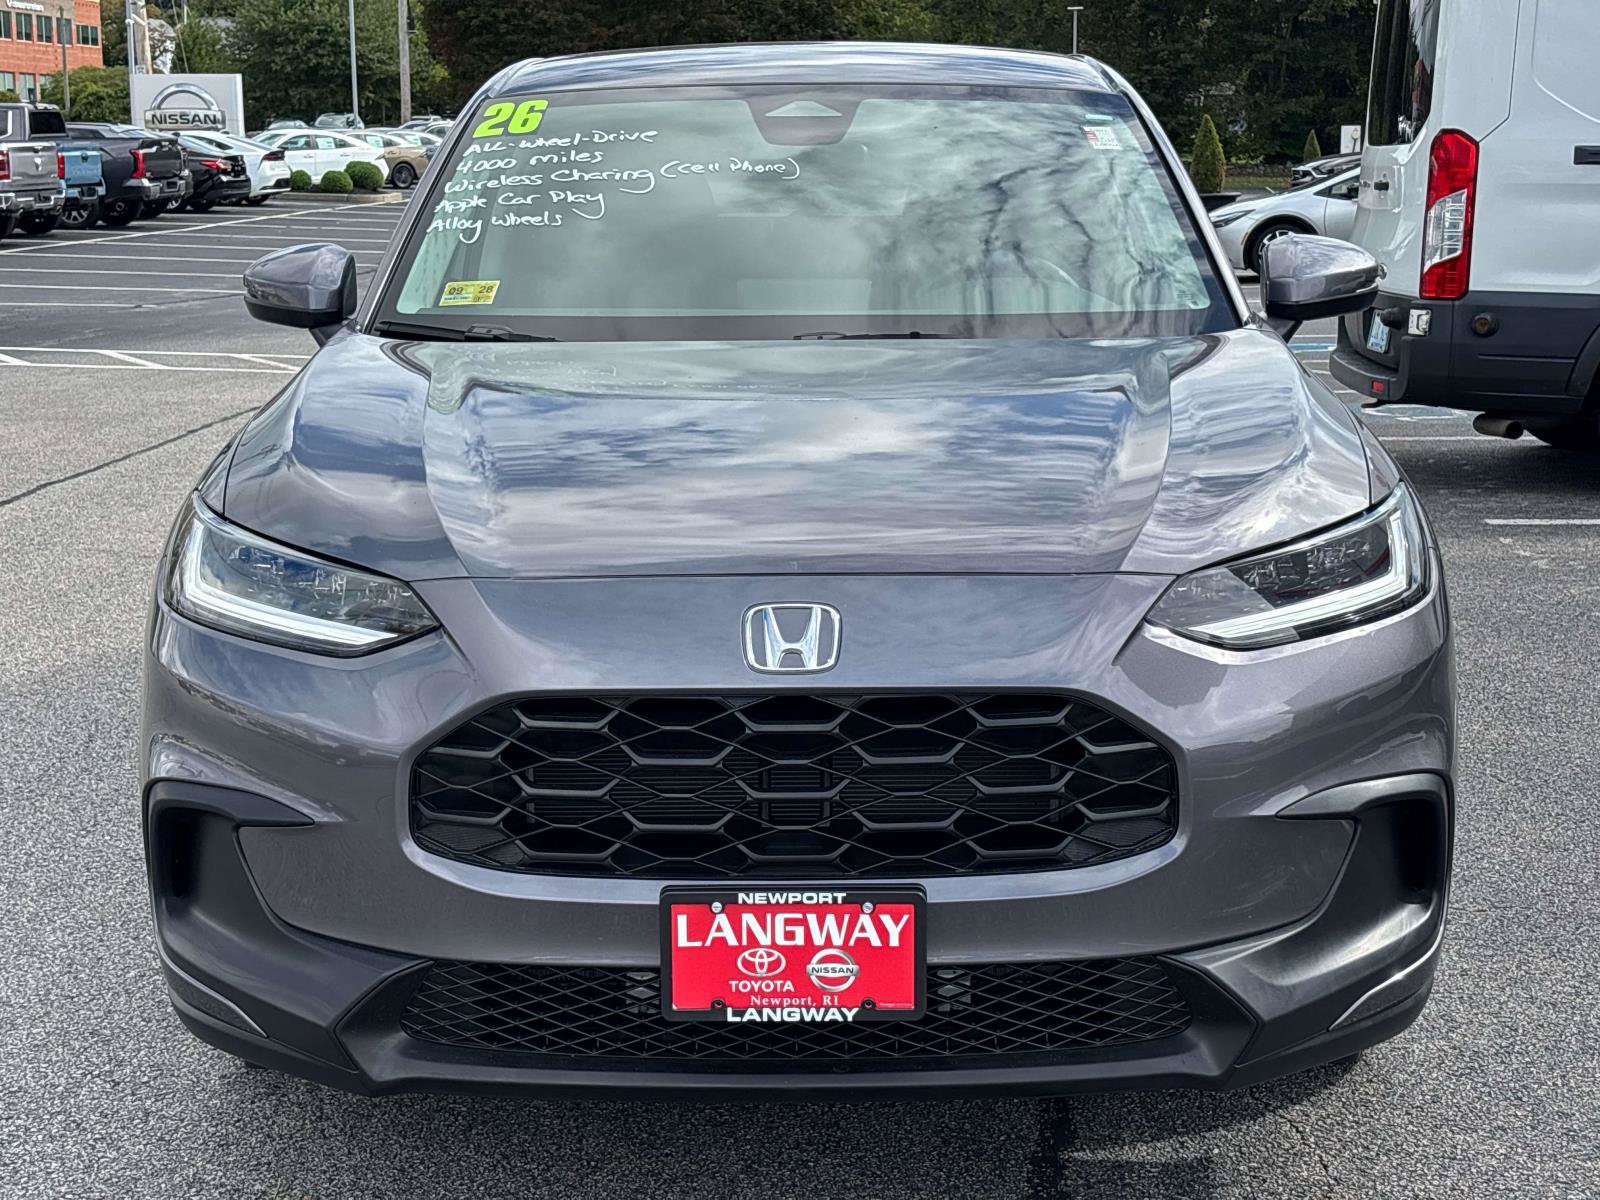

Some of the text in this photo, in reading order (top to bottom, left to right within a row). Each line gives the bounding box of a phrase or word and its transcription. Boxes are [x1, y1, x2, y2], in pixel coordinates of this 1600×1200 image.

[151, 113, 217, 125] NISSAN
[472, 99, 549, 138] 26
[456, 150, 604, 174] 4000 miles
[434, 190, 605, 219] Apple Car Play
[426, 217, 483, 244] Alloy
[738, 892, 846, 904] NEWPORT
[676, 912, 910, 948] LANGWAY
[811, 966, 855, 975] NISSAN
[729, 980, 795, 993] TOYOTA
[750, 994, 839, 1007] Newport, RI
[727, 1007, 859, 1022] LANGWAY
